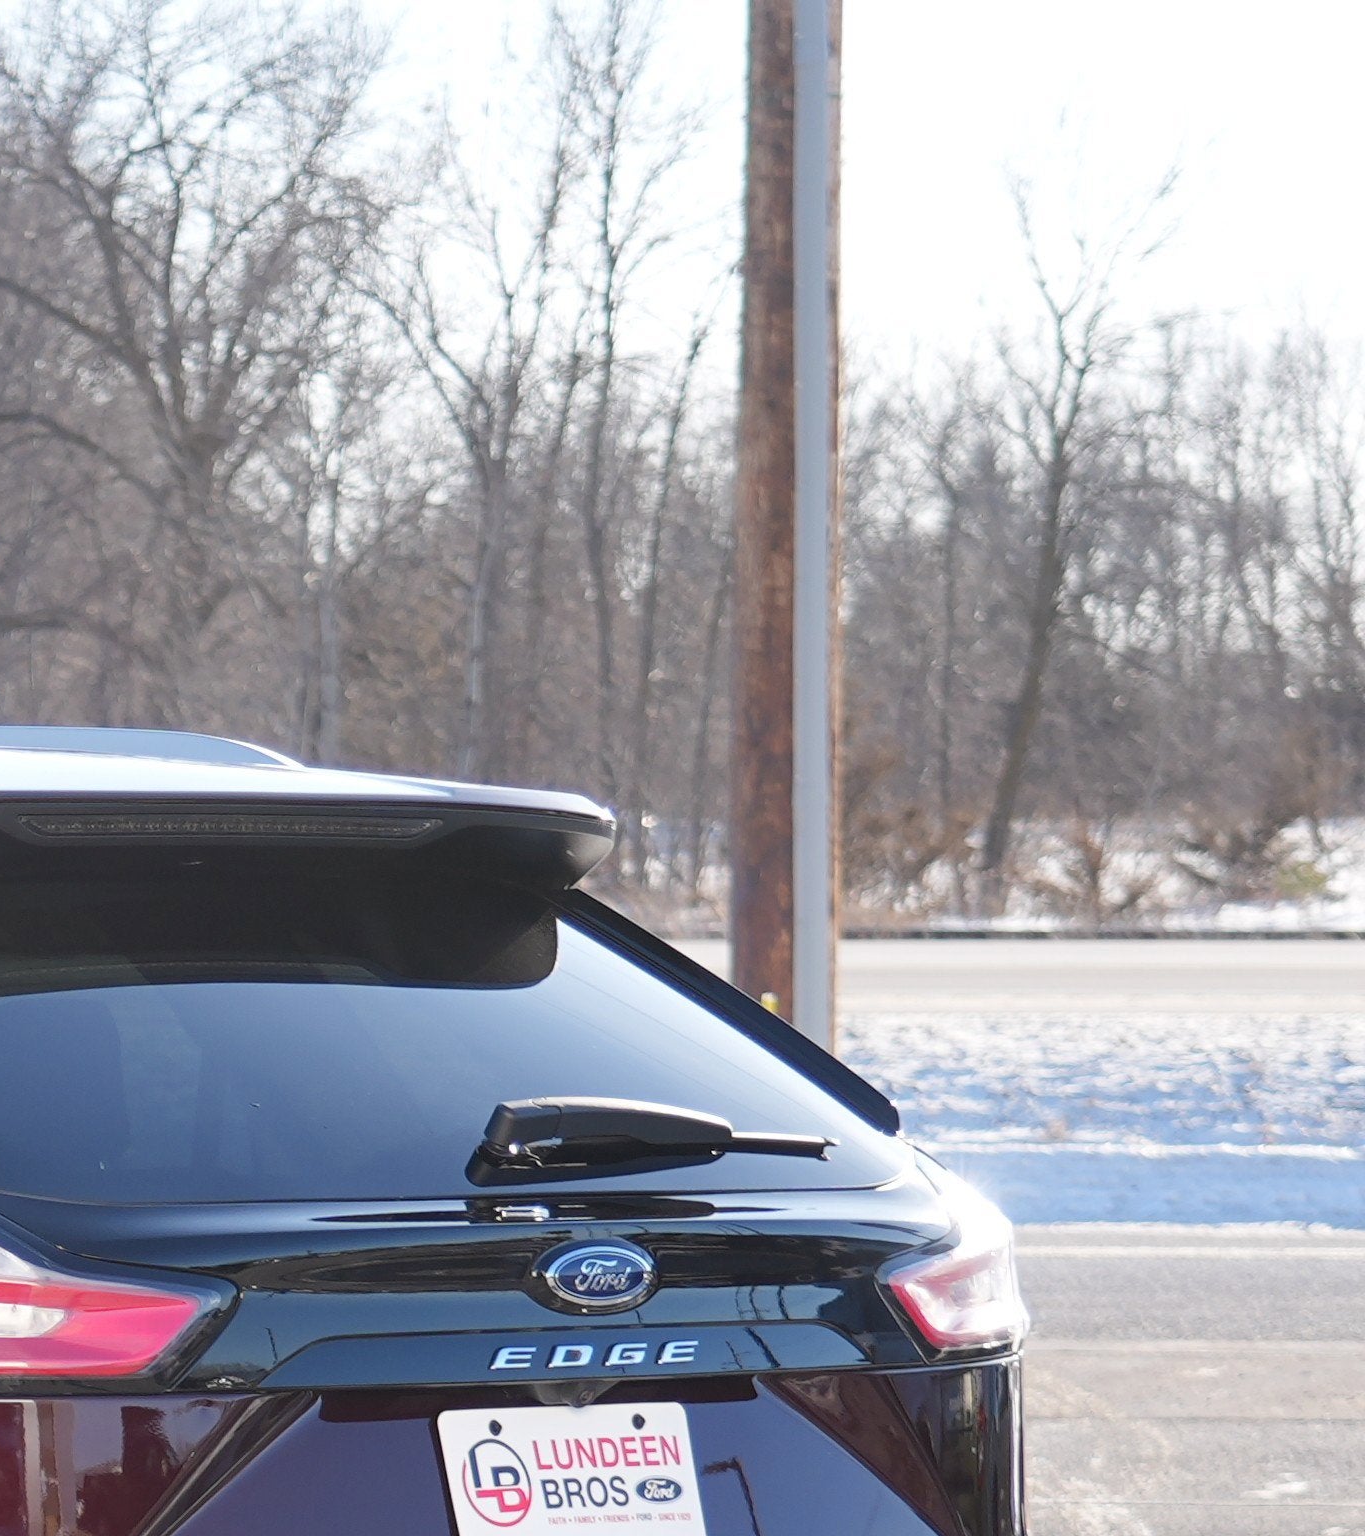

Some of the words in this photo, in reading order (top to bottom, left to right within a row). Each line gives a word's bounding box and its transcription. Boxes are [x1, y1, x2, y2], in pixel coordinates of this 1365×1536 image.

[575, 1259, 630, 1291] Ford
[490, 1340, 699, 1370] EDGE
[532, 1436, 681, 1470] LUNDEEN
[540, 1475, 630, 1509] BROS
[643, 1480, 676, 1502] Ford
